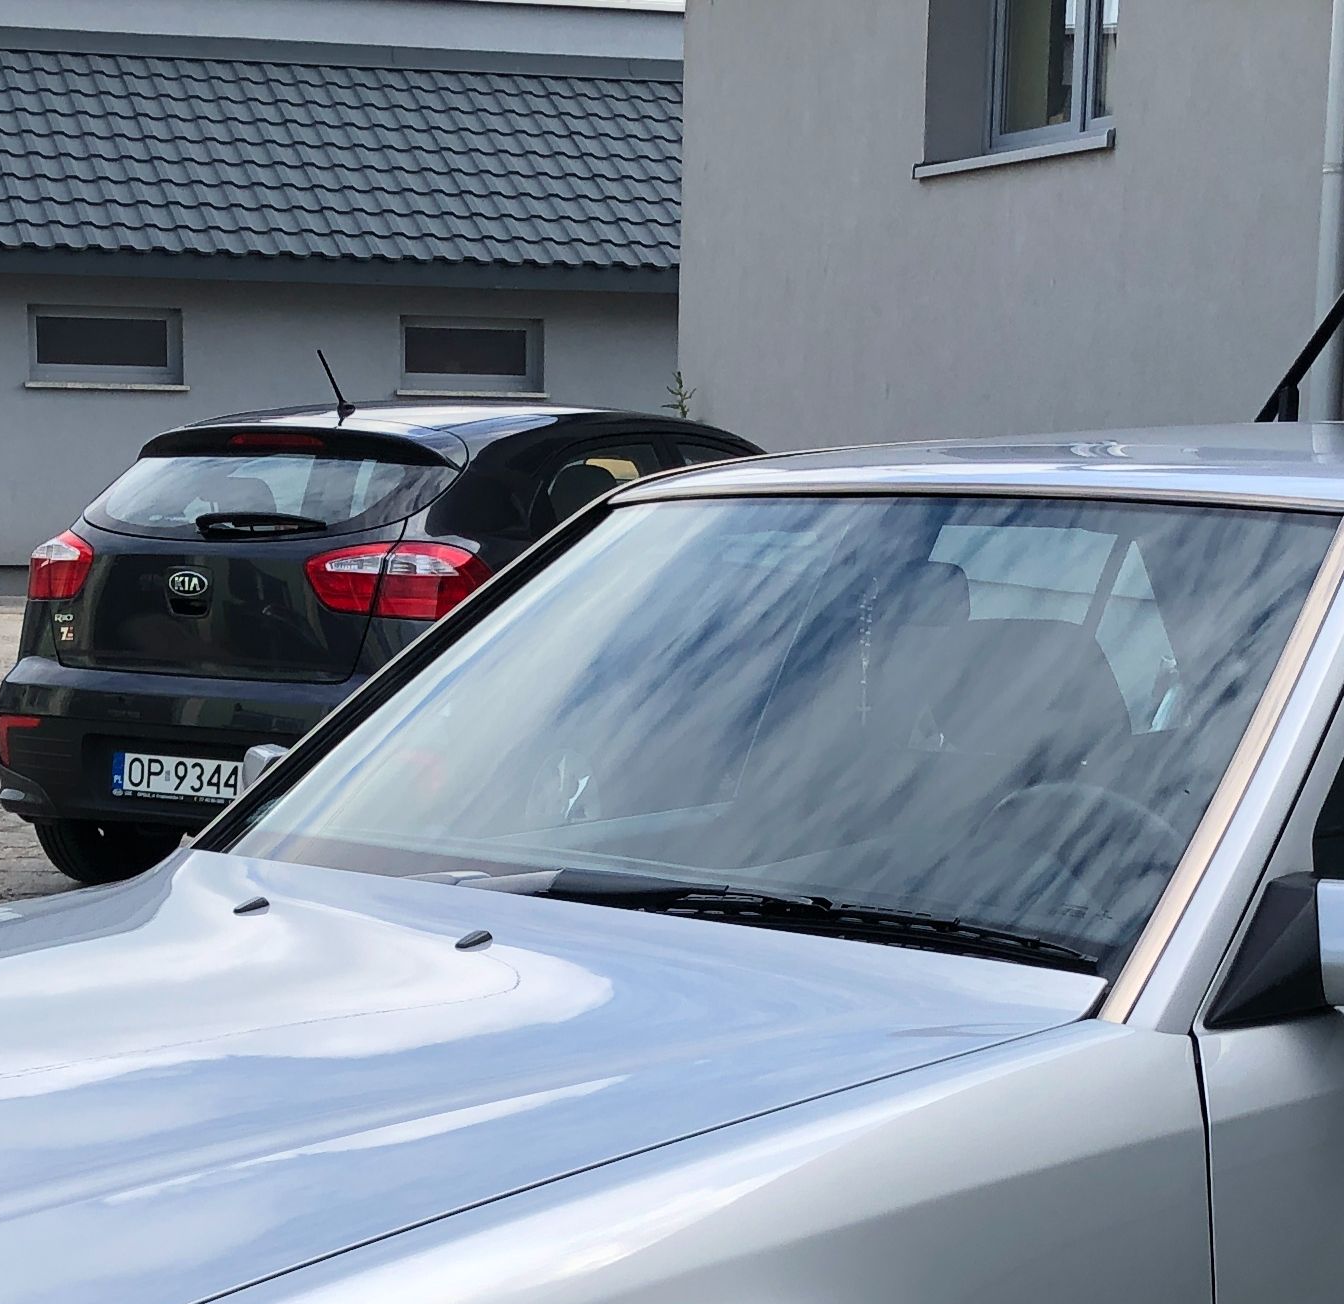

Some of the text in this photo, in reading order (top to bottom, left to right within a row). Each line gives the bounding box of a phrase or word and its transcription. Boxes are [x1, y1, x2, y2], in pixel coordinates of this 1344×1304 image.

[174, 576, 201, 591] KIA
[113, 774, 123, 784] PL
[128, 757, 239, 796] OP 9344
